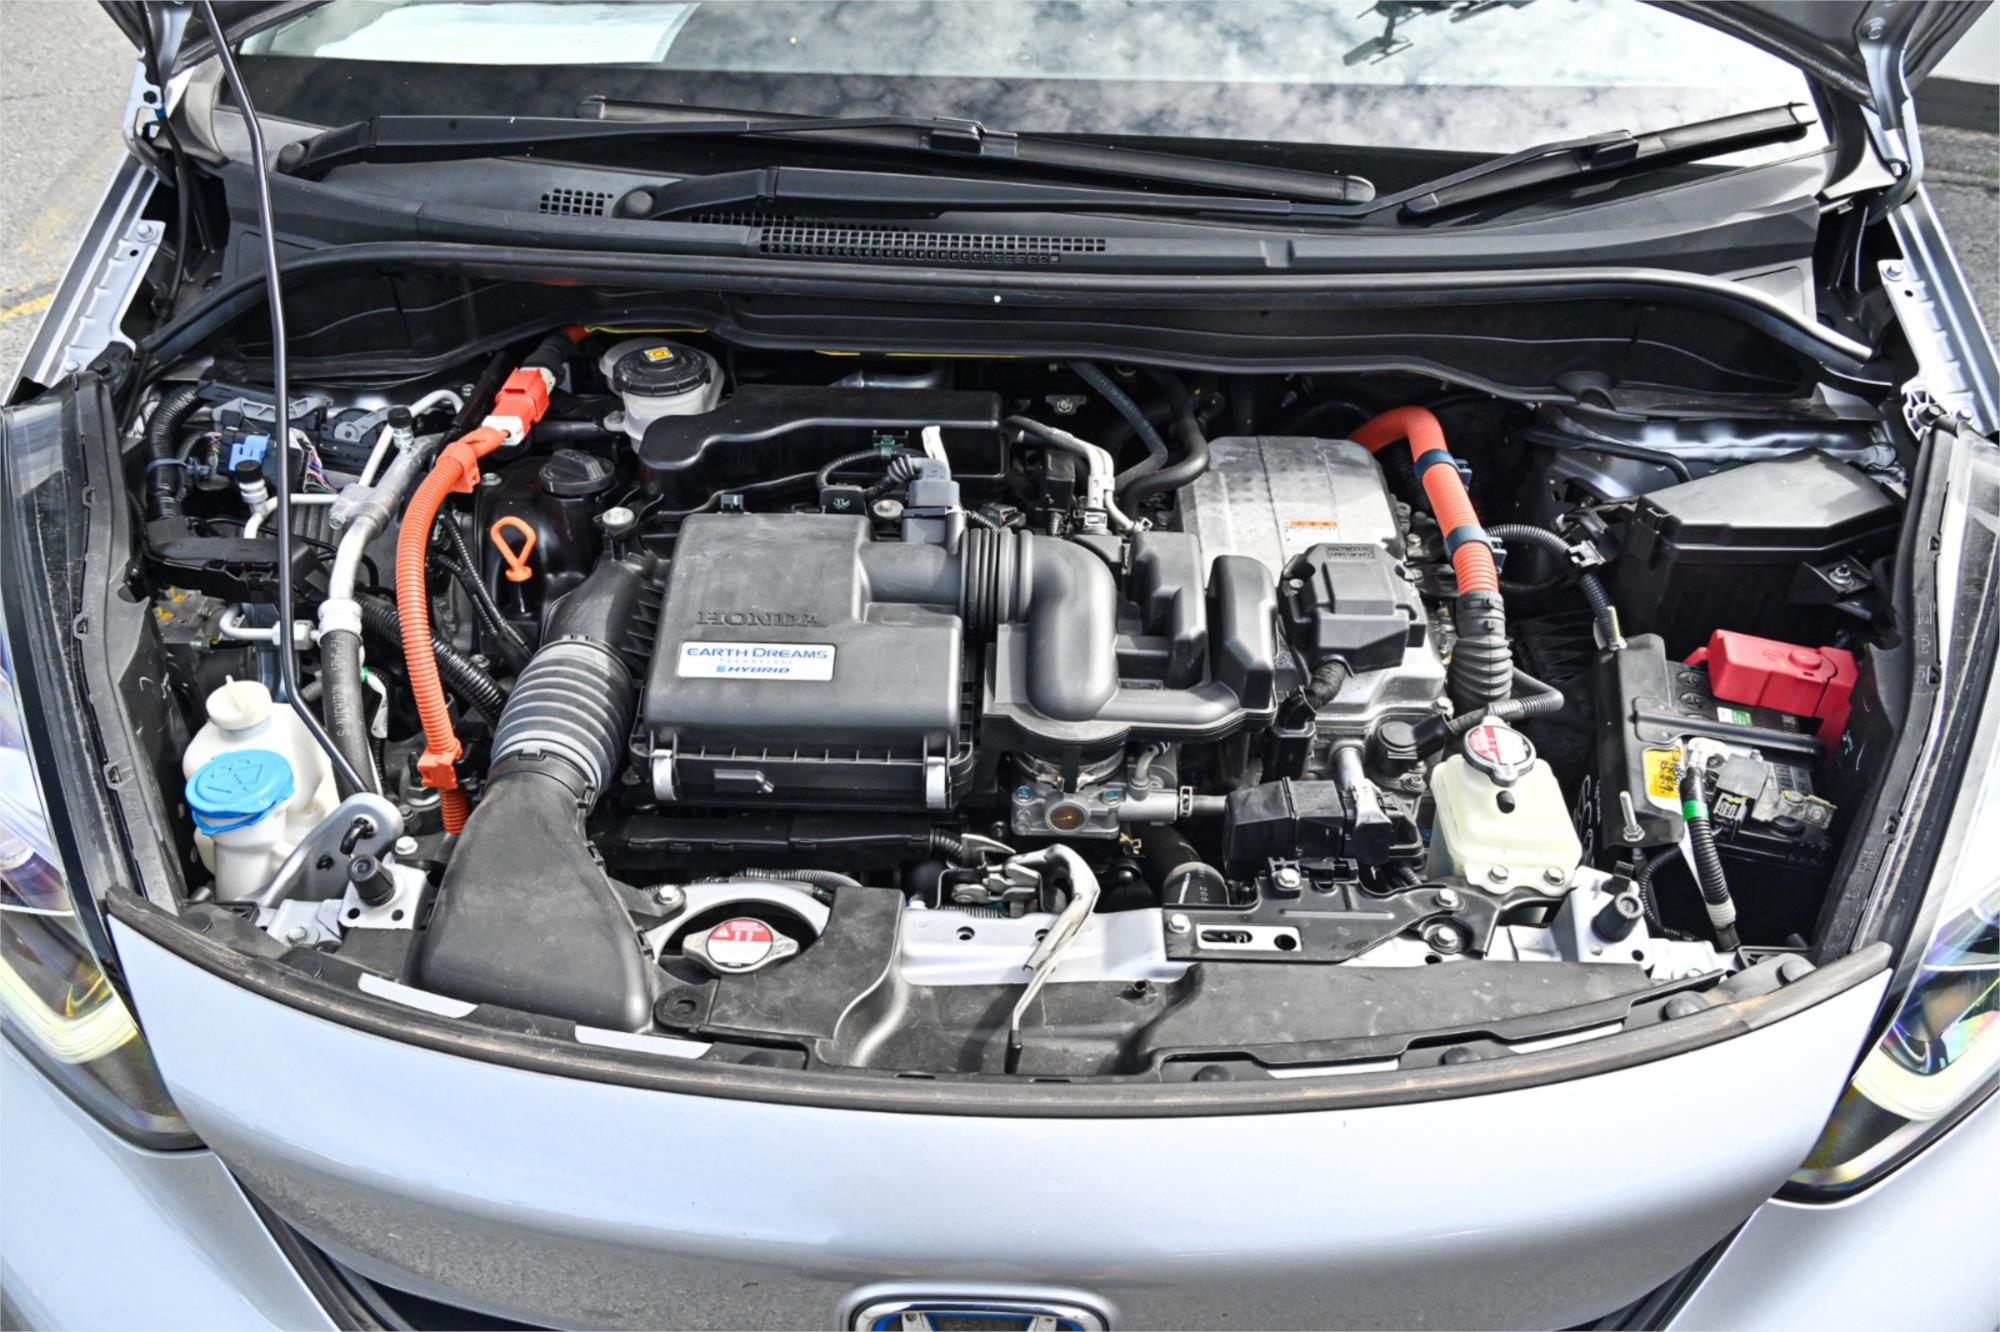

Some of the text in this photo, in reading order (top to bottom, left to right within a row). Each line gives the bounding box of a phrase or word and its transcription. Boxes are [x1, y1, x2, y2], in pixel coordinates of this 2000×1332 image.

[696, 611, 827, 627] HONDA
[687, 647, 828, 659] EARTH DREAMS
[728, 666, 790, 674] HYBRID
